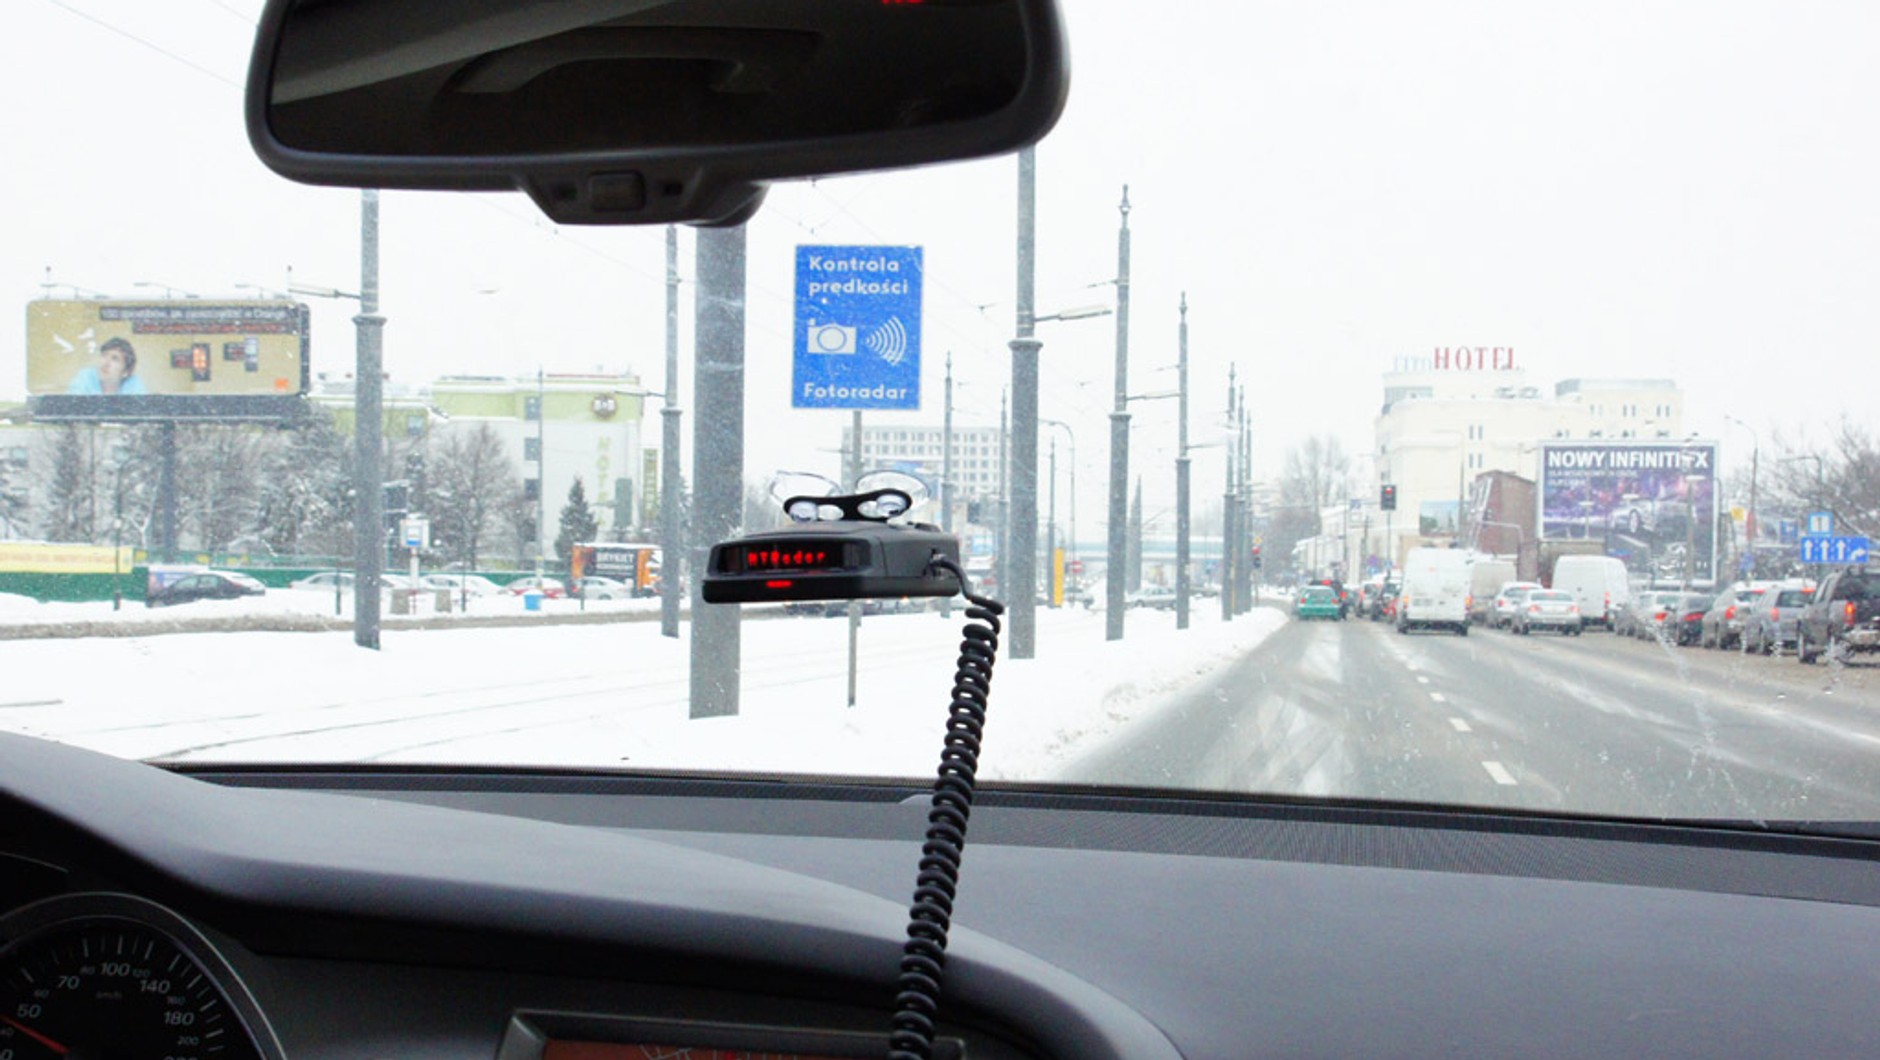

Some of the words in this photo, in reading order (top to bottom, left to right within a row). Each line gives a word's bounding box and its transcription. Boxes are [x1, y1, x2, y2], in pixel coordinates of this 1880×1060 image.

[809, 255, 899, 272] Kontrola
[809, 278, 908, 297] prędkości
[1434, 345, 1517, 371] HOTEL
[804, 382, 907, 399] Fotoradar
[1549, 451, 1605, 467] NOWY
[1610, 451, 1679, 468] INFINITI
[101, 962, 130, 976] 100
[132, 968, 151, 978] 120
[58, 975, 80, 989] 70
[140, 979, 170, 994] 140
[18, 1003, 41, 1018] 50
[164, 1011, 194, 1025] 180
[178, 1036, 199, 1045] 200
